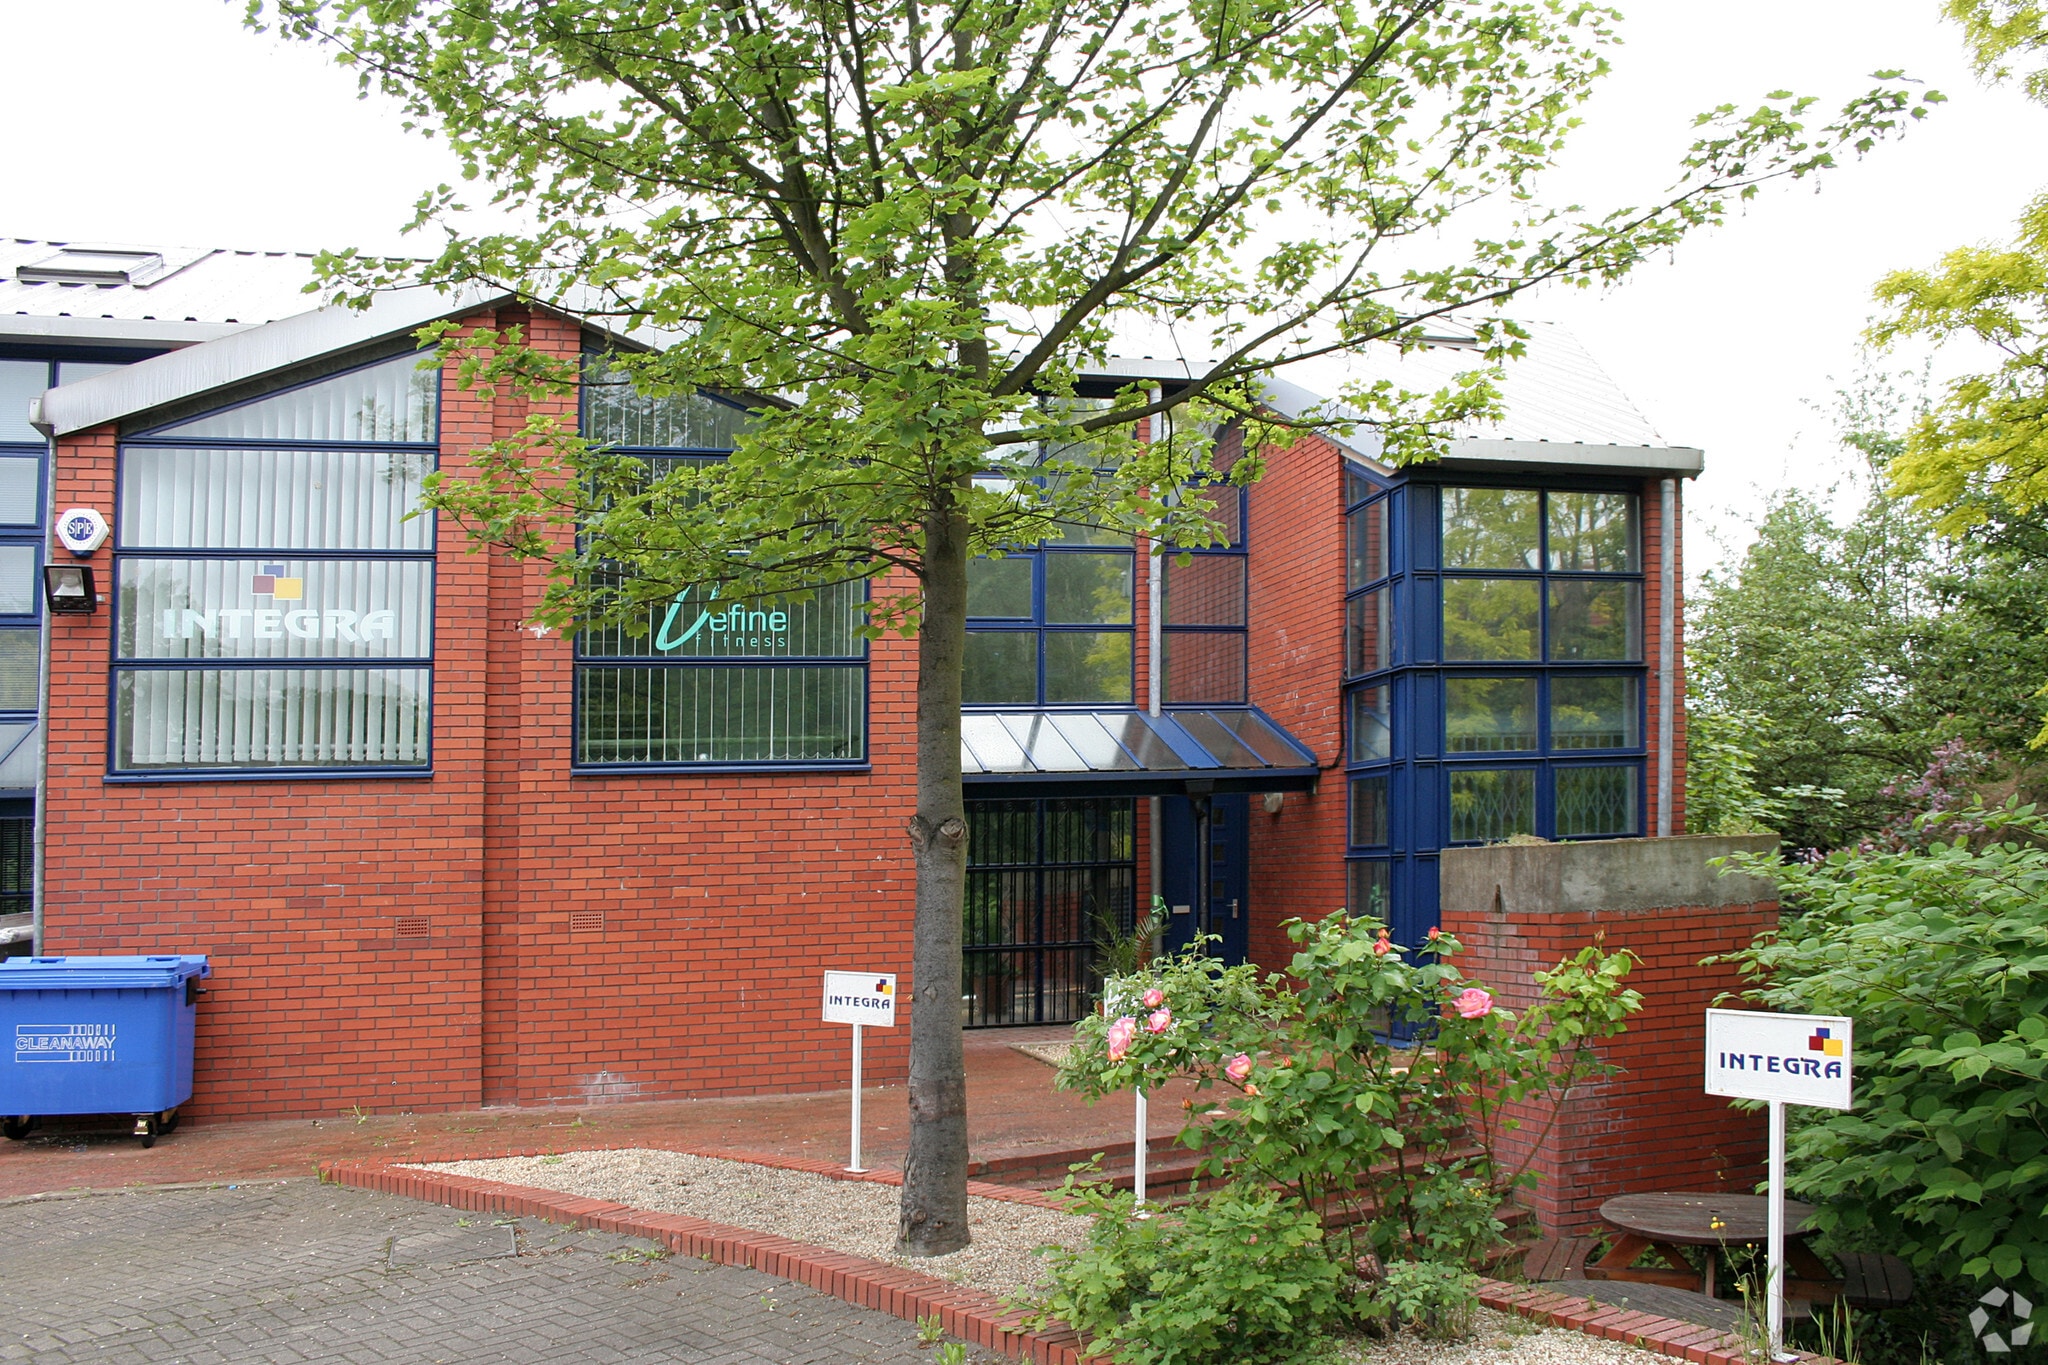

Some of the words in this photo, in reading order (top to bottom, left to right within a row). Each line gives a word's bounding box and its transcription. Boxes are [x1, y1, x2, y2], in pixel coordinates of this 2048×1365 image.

[163, 608, 395, 642] INTEGRA
[695, 633, 786, 647] fitness
[829, 995, 891, 1010] INTEGRA
[15, 1036, 117, 1051] CLEANAWAY
[1720, 1051, 1842, 1079] INTEGRA
